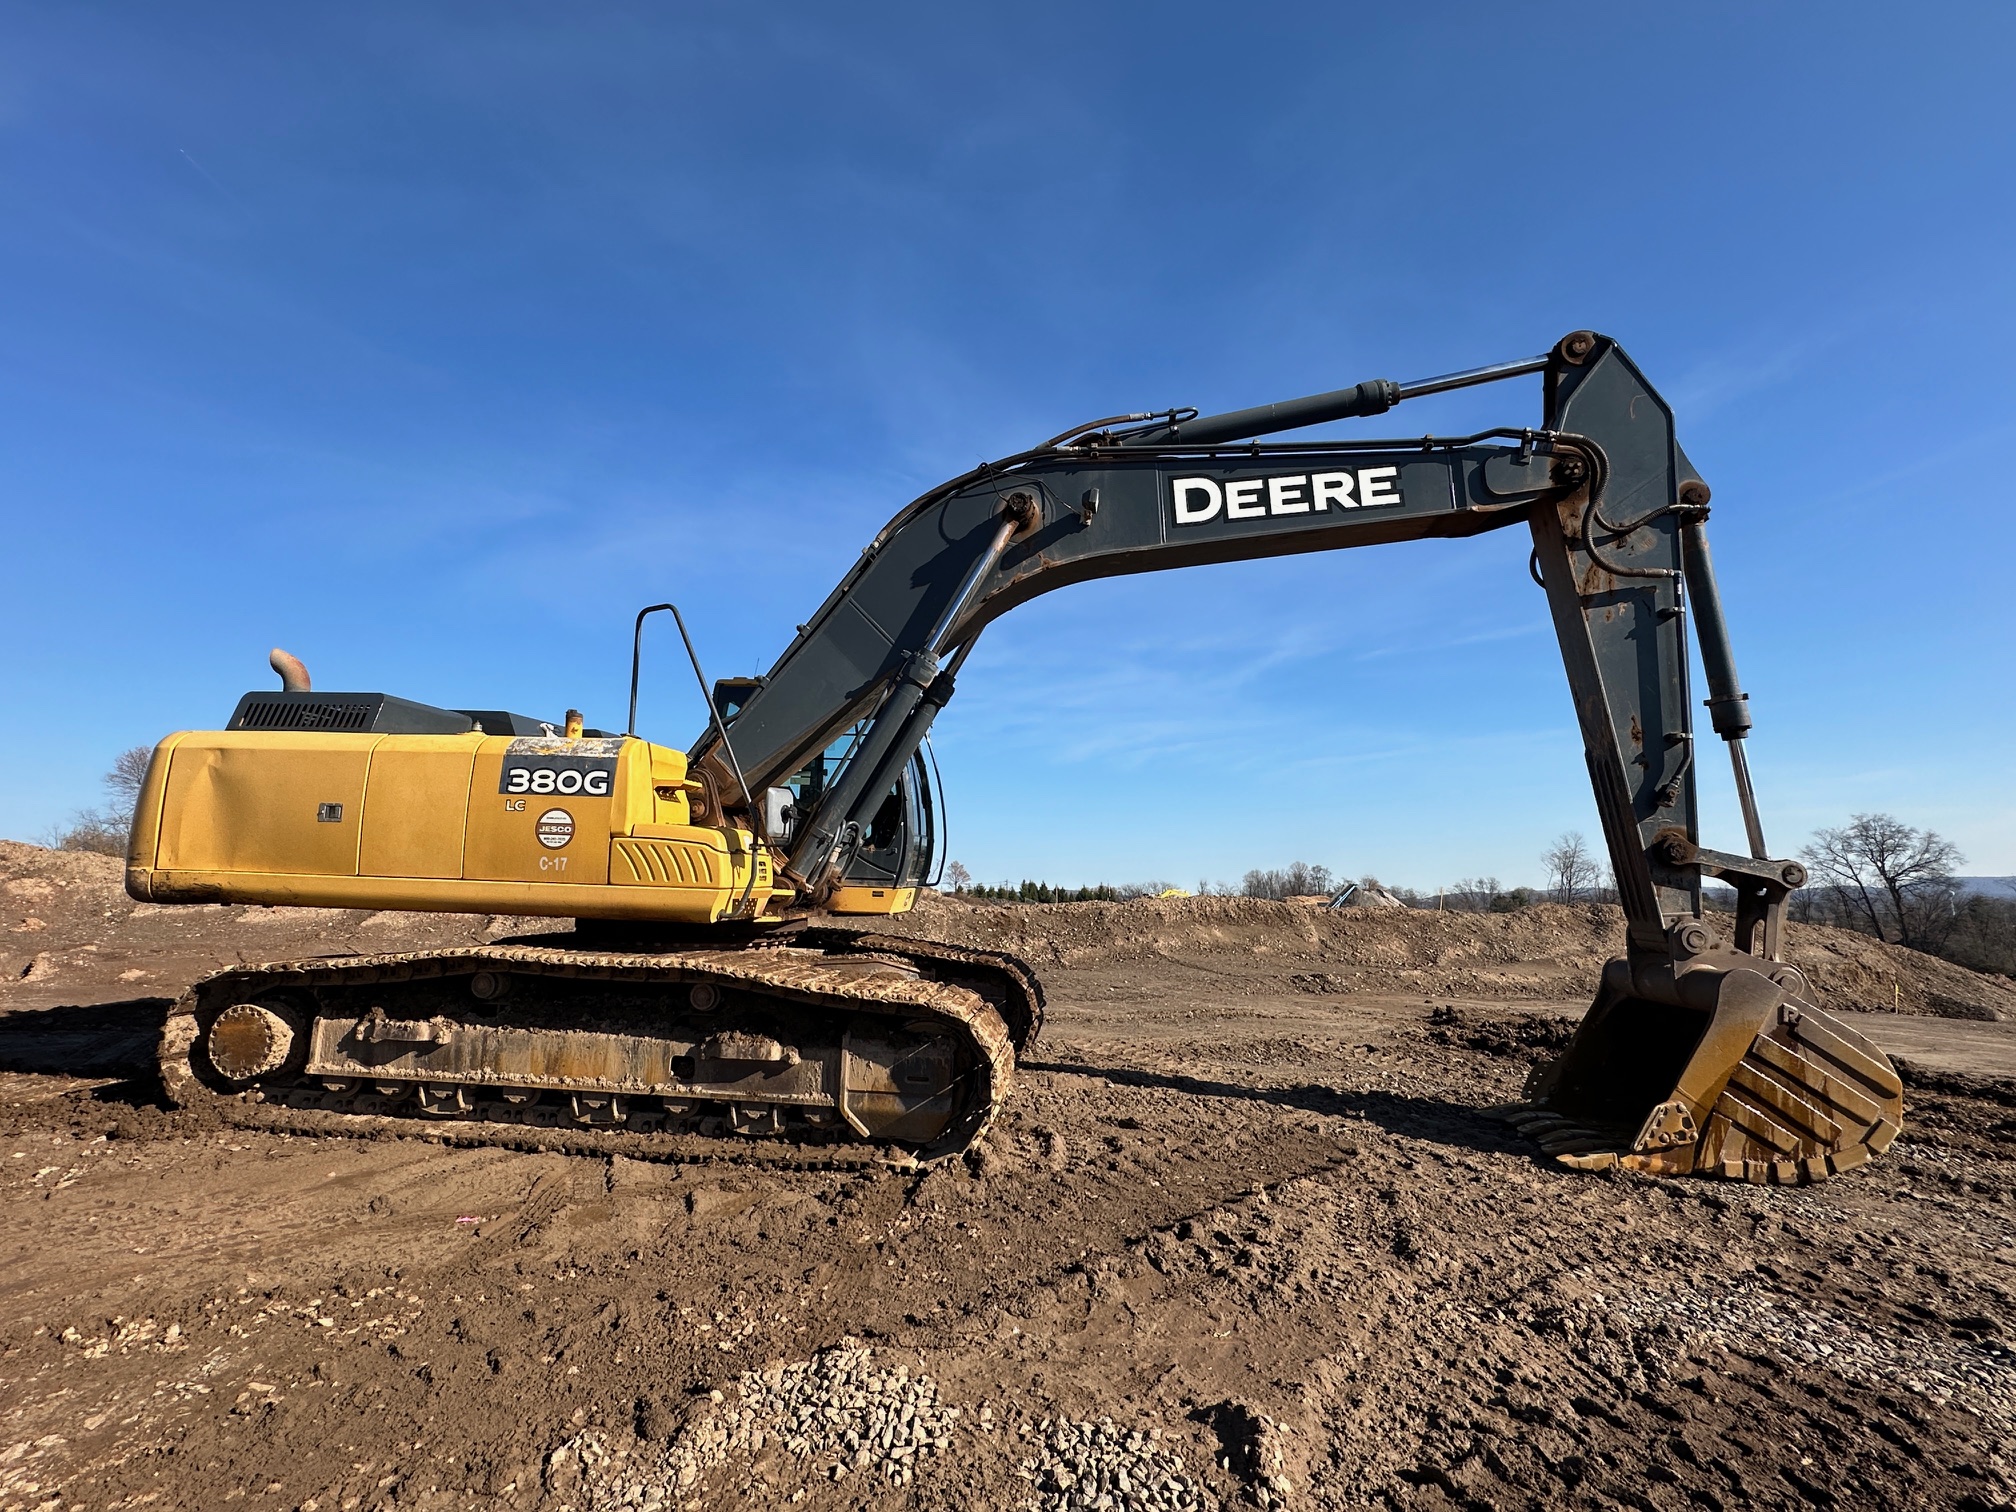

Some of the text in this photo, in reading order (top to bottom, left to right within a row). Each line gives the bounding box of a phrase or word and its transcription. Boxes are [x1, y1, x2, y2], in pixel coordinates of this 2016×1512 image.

[1173, 466, 1400, 524] DEERE
[507, 768, 609, 795] 380G
[505, 800, 526, 811] LC
[539, 825, 572, 833] JESCO
[540, 857, 567, 870] C-17
